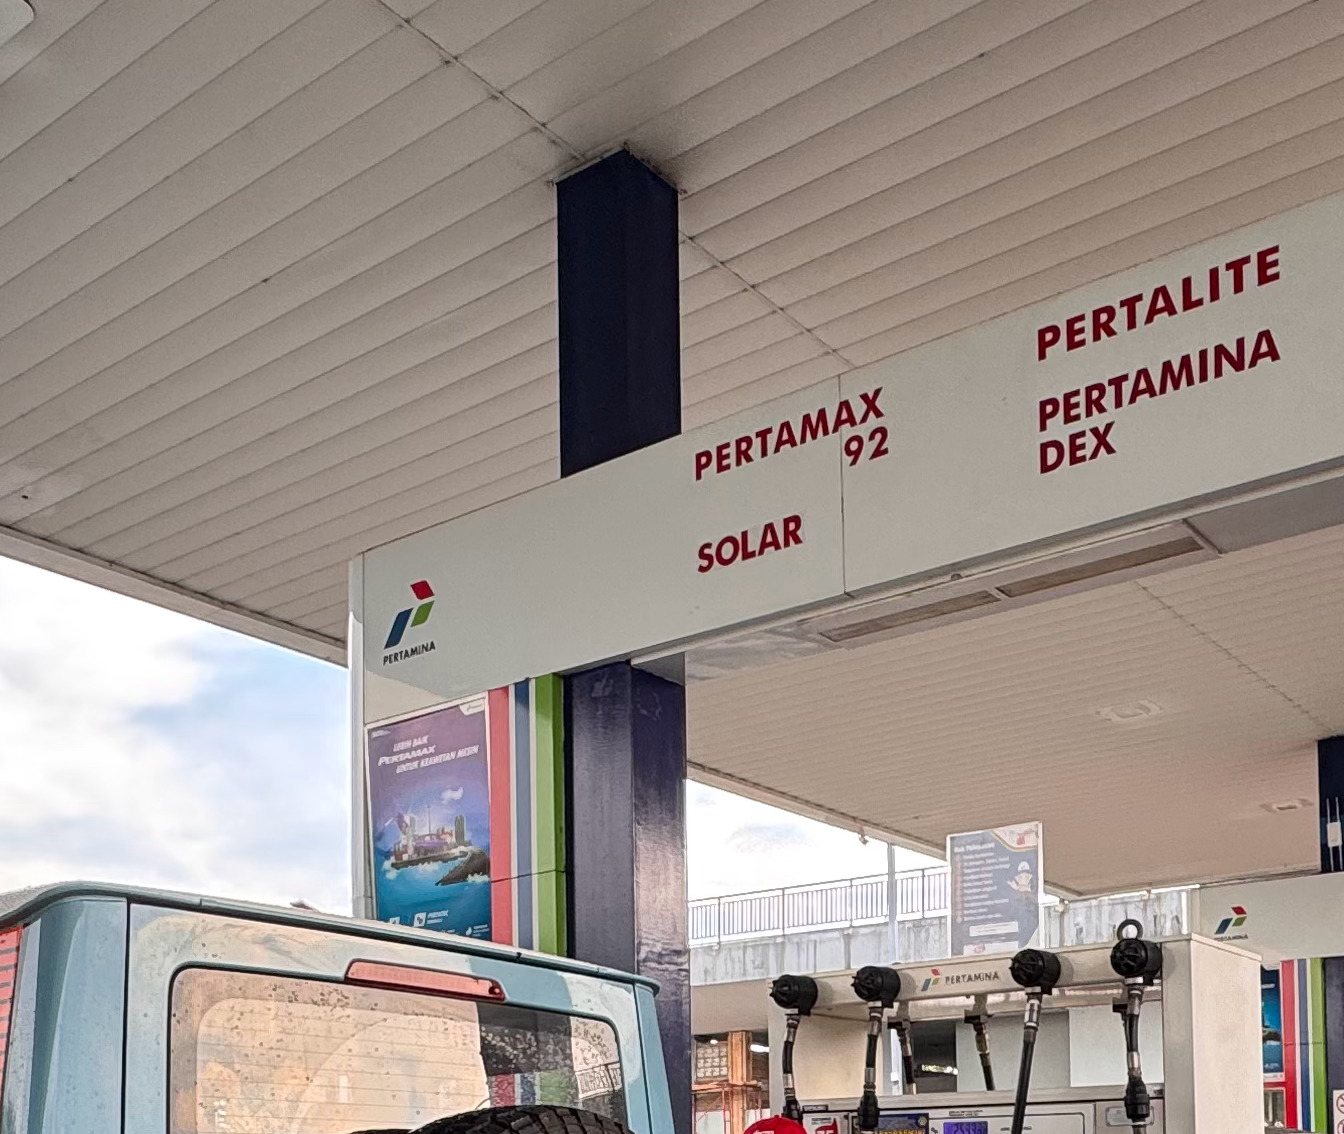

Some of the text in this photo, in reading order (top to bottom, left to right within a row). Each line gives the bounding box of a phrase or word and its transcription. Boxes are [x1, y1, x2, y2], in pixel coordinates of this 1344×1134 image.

[1038, 246, 1280, 362] PERTALITE
[1039, 329, 1280, 433] PERTAMINA
[694, 386, 885, 481] PERTAMAX
[843, 425, 888, 467] 92
[1039, 421, 1118, 475] DEX
[697, 514, 803, 573] SOLAR
[382, 640, 436, 666] PERTAMINA
[377, 745, 437, 767] PERTAMAX
[944, 970, 1001, 986] PERTAMINA
